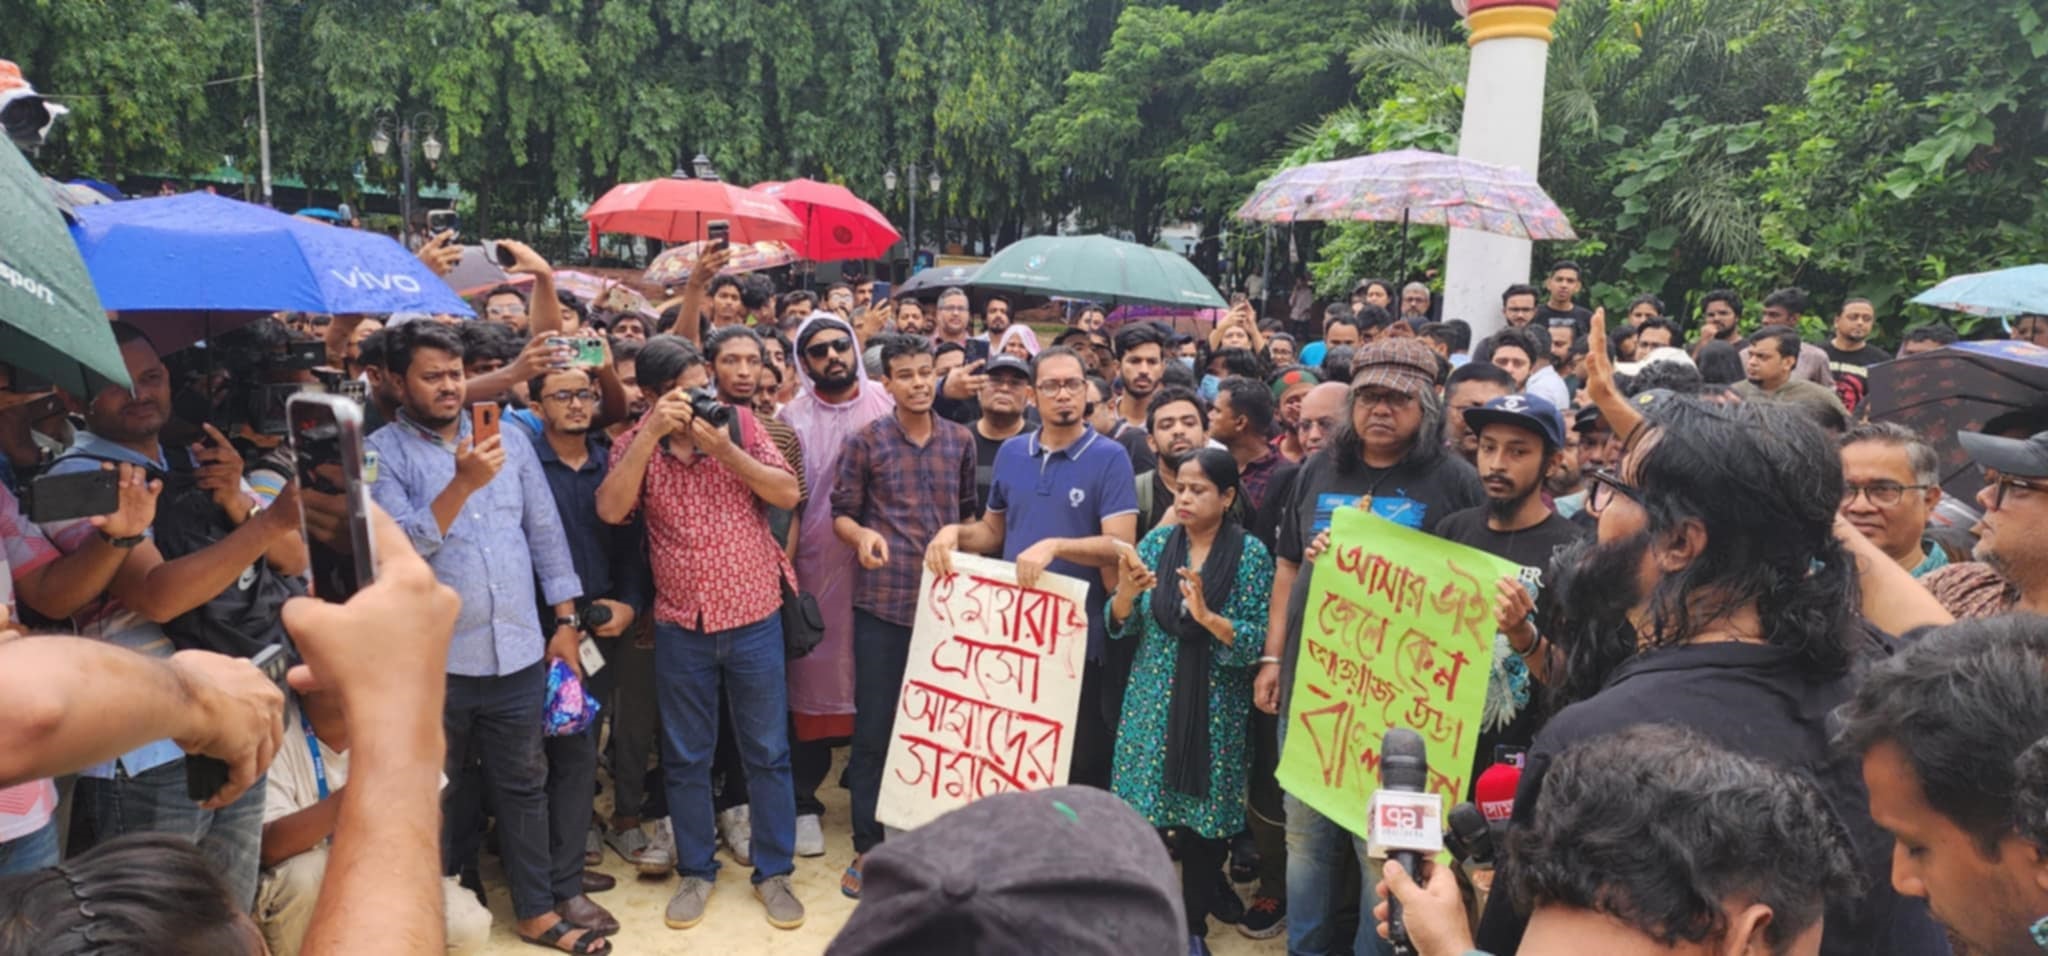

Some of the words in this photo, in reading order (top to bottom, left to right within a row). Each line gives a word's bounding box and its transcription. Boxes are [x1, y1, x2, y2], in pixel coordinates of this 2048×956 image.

[330, 265, 421, 293] vivo
[961, 574, 1089, 679] মহারাজ
[1317, 591, 1394, 662] জেলে
[1395, 627, 1471, 702] কেন
[1336, 544, 1428, 617] আমার
[1430, 559, 1490, 652] ভাই
[931, 634, 1041, 704] এসো
[902, 679, 1064, 786] আমাদের
